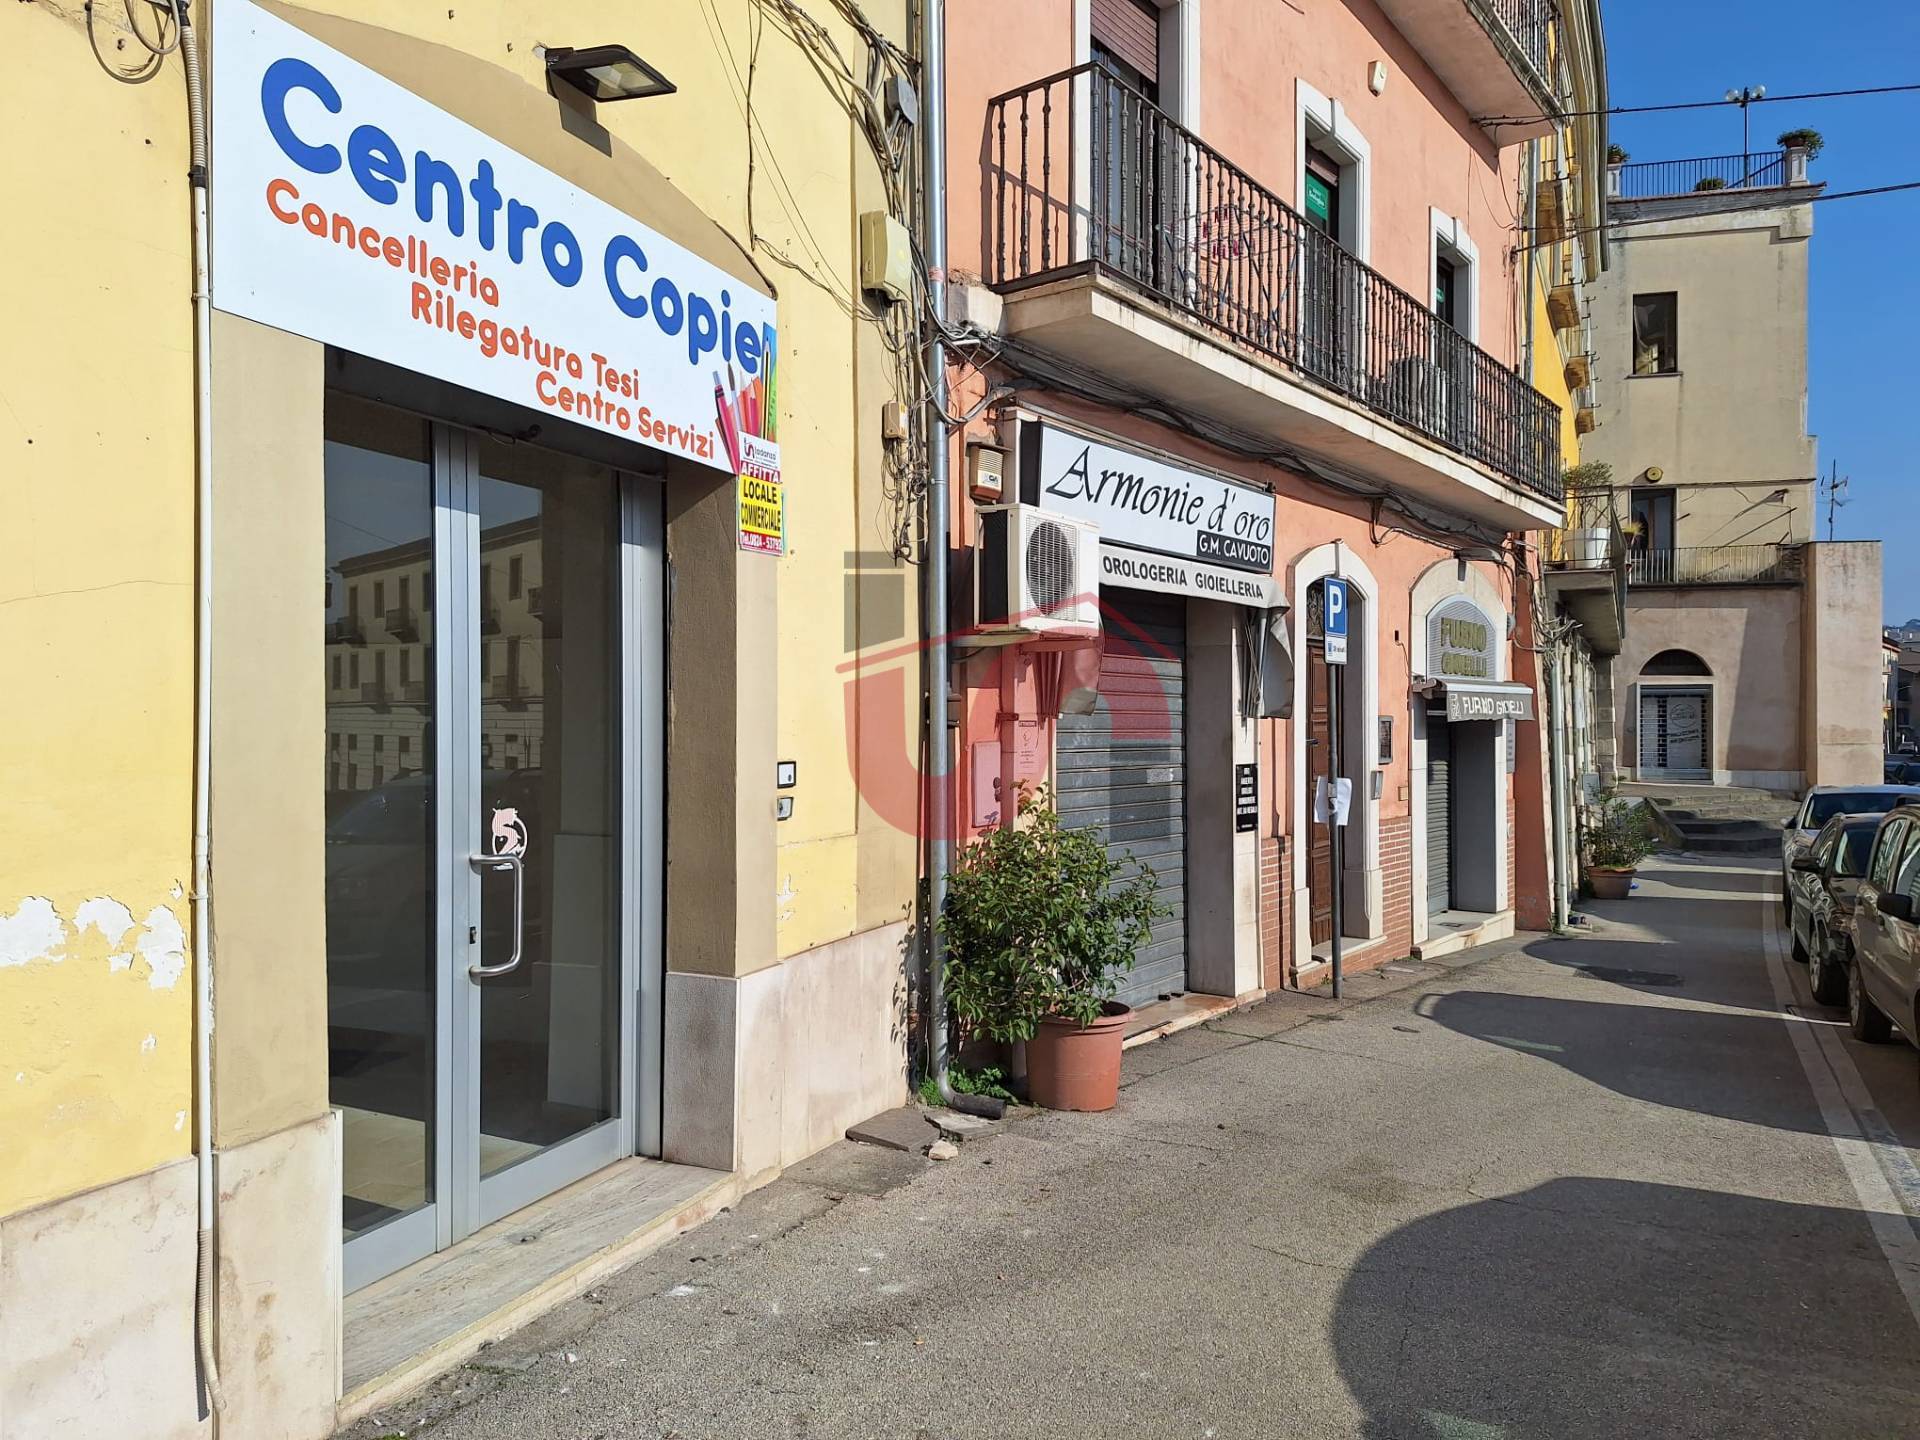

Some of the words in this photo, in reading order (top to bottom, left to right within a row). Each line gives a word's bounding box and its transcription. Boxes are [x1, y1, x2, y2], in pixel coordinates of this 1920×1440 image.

[260, 57, 583, 288] Centro
[603, 234, 762, 374] Copie
[266, 179, 499, 307] Cancelleria
[411, 282, 583, 380] Rilegatura
[591, 352, 639, 399] Tesi
[535, 371, 632, 431] Centro
[637, 406, 714, 460] Servizi
[741, 462, 780, 483] AFFITTA
[743, 478, 778, 505] LOCALE
[1045, 445, 1204, 525] Armonie
[741, 503, 781, 532] COMMERCIALE
[1199, 534, 1221, 557] G.M.
[1223, 539, 1269, 565] CAVUOTO
[1102, 555, 1188, 586] OROLOGERIA
[1195, 572, 1264, 599] GIOIELLERIA
[1329, 584, 1343, 628] P
